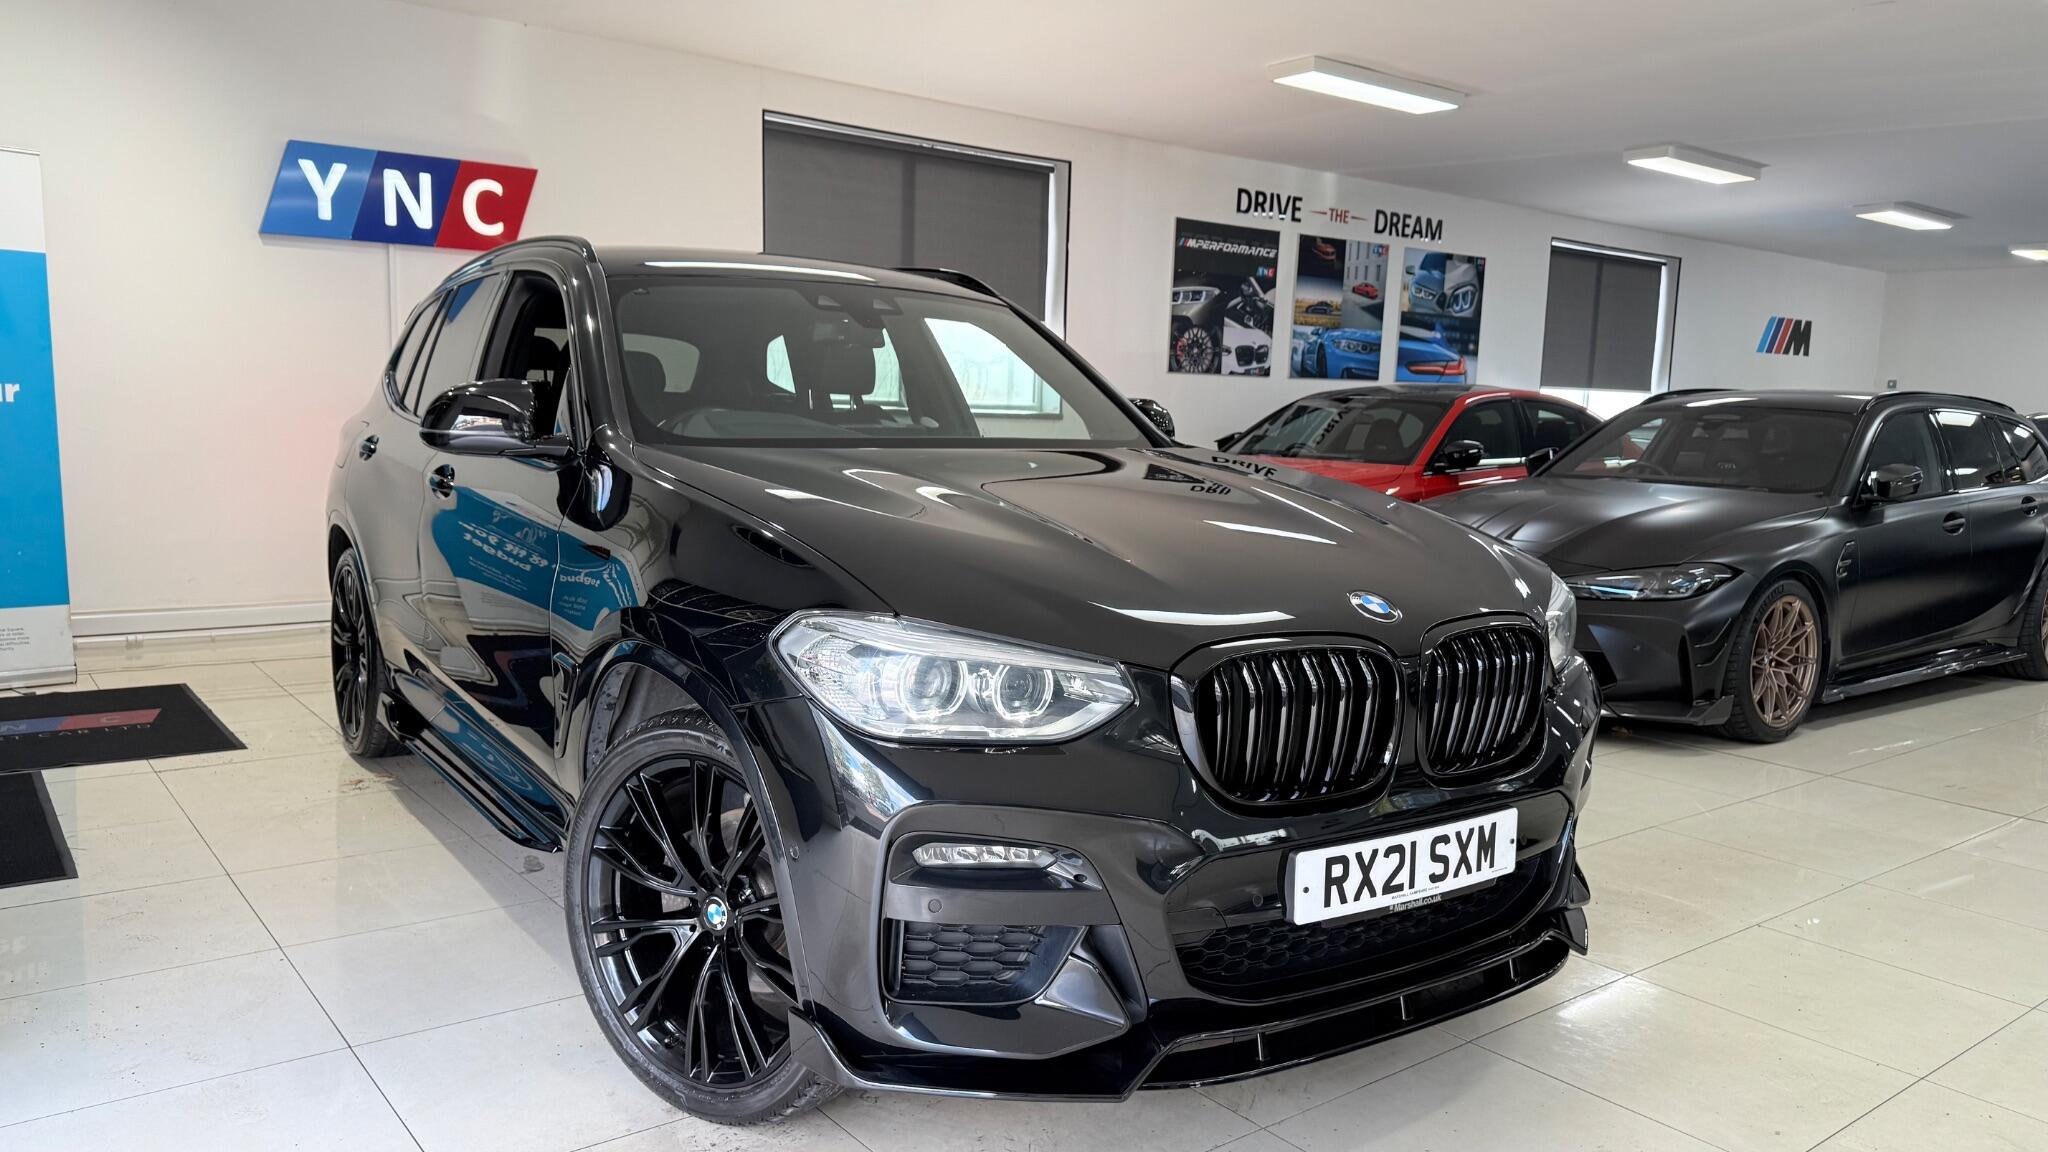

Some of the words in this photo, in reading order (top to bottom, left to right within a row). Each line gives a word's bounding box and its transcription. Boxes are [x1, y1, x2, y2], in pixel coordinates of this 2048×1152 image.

[297, 158, 505, 237] YNC
[1236, 187, 1303, 223] DRIVE
[1328, 207, 1350, 225] THE
[1374, 208, 1443, 242] DREAM
[1323, 841, 1418, 909] RX21
[1428, 821, 1498, 885] SXM
